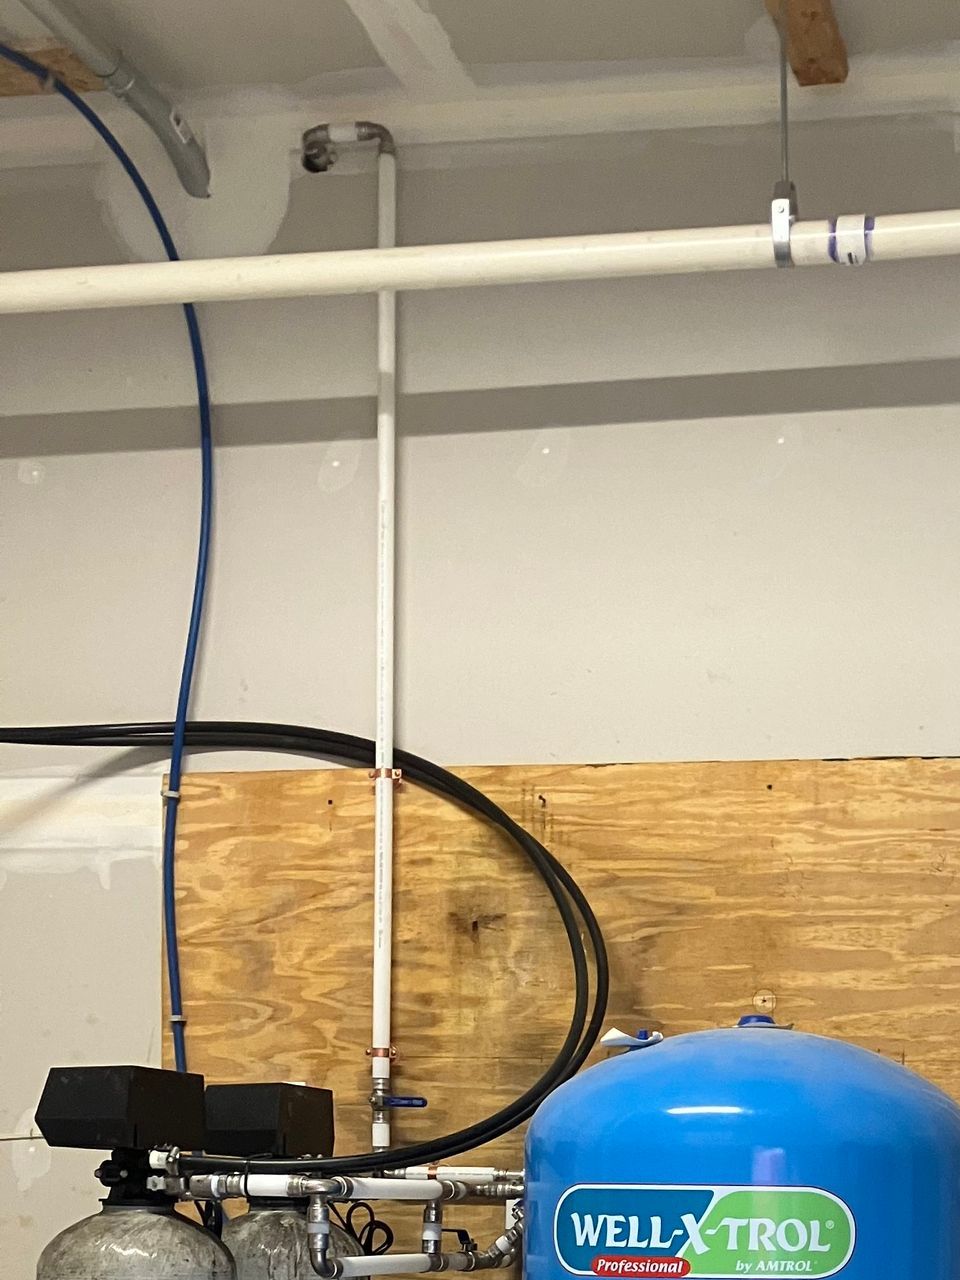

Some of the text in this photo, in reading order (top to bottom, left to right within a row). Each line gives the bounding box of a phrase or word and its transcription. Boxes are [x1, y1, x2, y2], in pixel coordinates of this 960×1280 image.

[597, 1258, 683, 1275] Professional
[735, 1260, 812, 1272] by AMTROL
